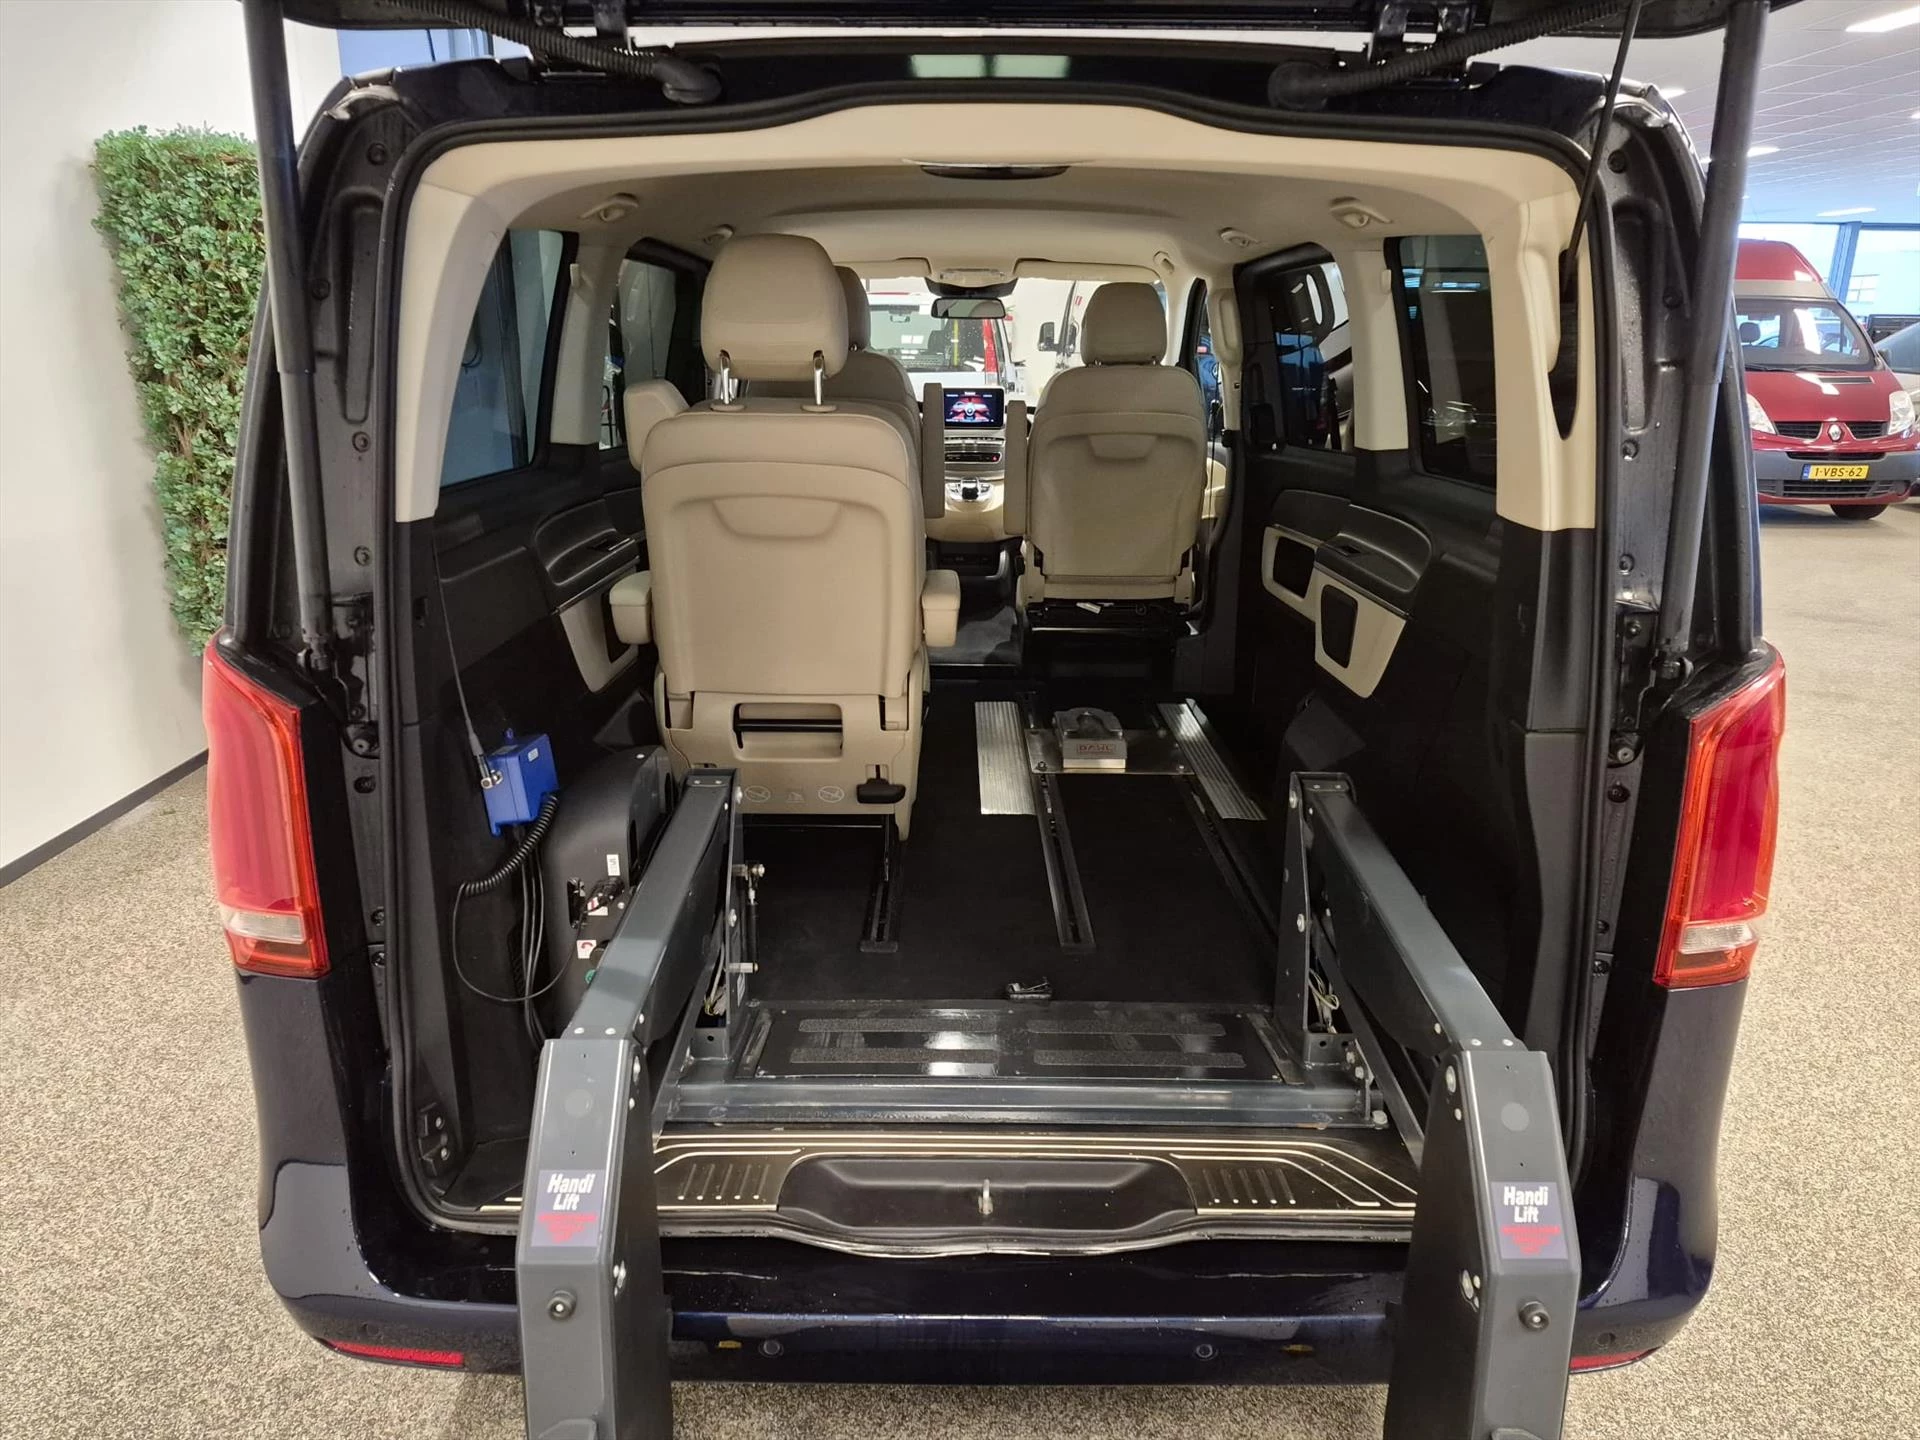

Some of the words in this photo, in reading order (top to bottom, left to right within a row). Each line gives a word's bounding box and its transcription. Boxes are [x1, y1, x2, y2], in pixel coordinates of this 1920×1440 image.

[1815, 467, 1863, 477] 1-VBS-62
[547, 1173, 596, 1194] Handi
[552, 1193, 580, 1211] Lift
[1503, 1186, 1549, 1206] Handi
[1514, 1205, 1539, 1223] Lift
